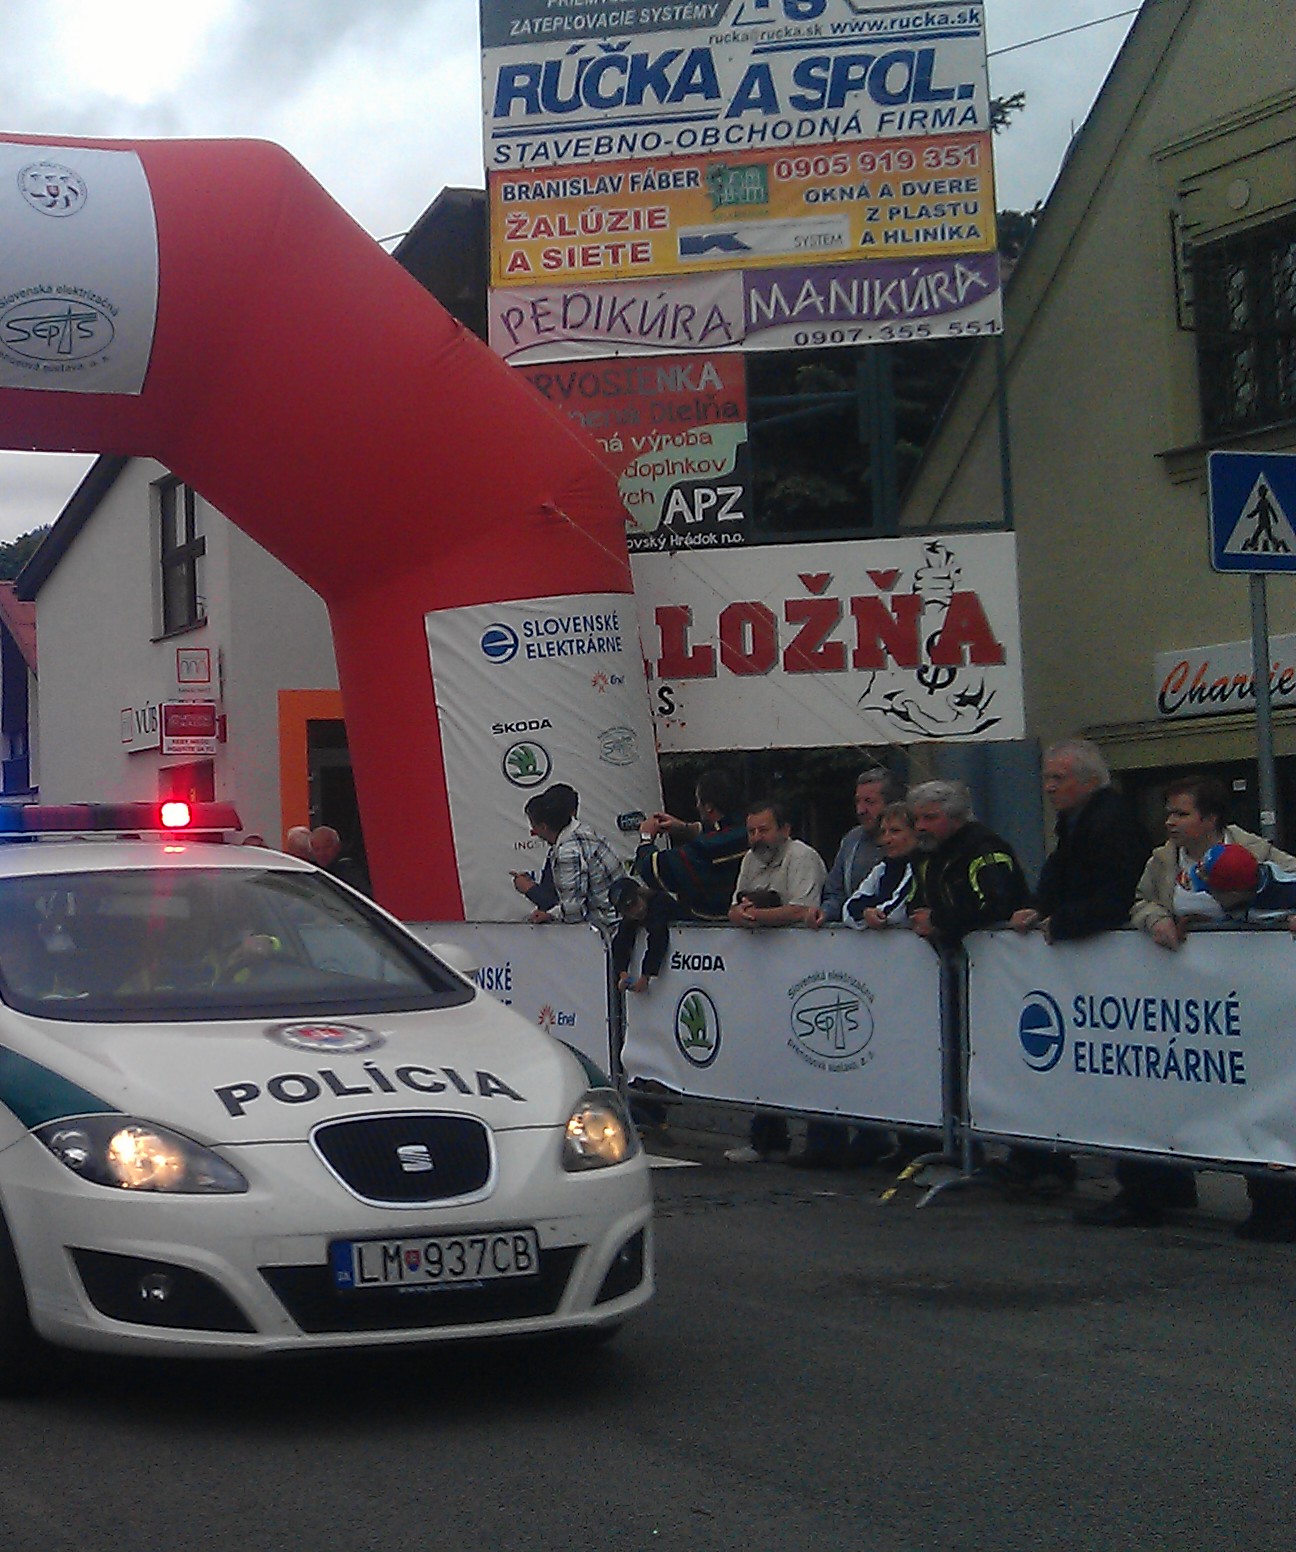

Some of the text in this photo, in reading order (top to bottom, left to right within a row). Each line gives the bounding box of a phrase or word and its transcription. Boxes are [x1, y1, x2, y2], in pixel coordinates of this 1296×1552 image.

[640, 4, 719, 24] SYSTÉMY
[830, 8, 981, 35] www.rucka.sk
[493, 40, 976, 119] RÚČKA A SPOL.
[493, 105, 979, 164] STAVEBNO-OBCHODNÁ FIRMA
[775, 145, 979, 180] 0905 919 351
[502, 174, 623, 202] BRANISLAV
[629, 168, 701, 193] FÁBER
[805, 178, 979, 204] OKNÁ A DVERE
[505, 206, 670, 241] ŽALÚZIE
[865, 201, 979, 222] Z PLASTU
[793, 232, 844, 249] SYSTEM
[860, 222, 982, 247] A HLINÍKA
[506, 240, 653, 274] A SIETE
[500, 263, 990, 346] PEDIKÚRA MANIKÚRA
[631, 428, 714, 453] výroba
[625, 457, 728, 481] doplnkov
[663, 485, 745, 525] APZ
[626, 533, 667, 551] ovský
[669, 531, 718, 547] Hrádok
[523, 610, 620, 639] SLOVENSKÉ
[645, 568, 1007, 680] LOŽŇA
[525, 633, 623, 660] ELEKTRÁRNE
[1157, 660, 1296, 714] Charie
[491, 718, 553, 735] ŠKODA
[475, 961, 513, 991] NSKÉ
[670, 950, 726, 972] ŠKODA
[1072, 990, 1242, 1037] SLOVENSKÉ
[1073, 1037, 1247, 1085] ELEKTRÁRNE
[213, 1060, 528, 1117] POLÍCIA
